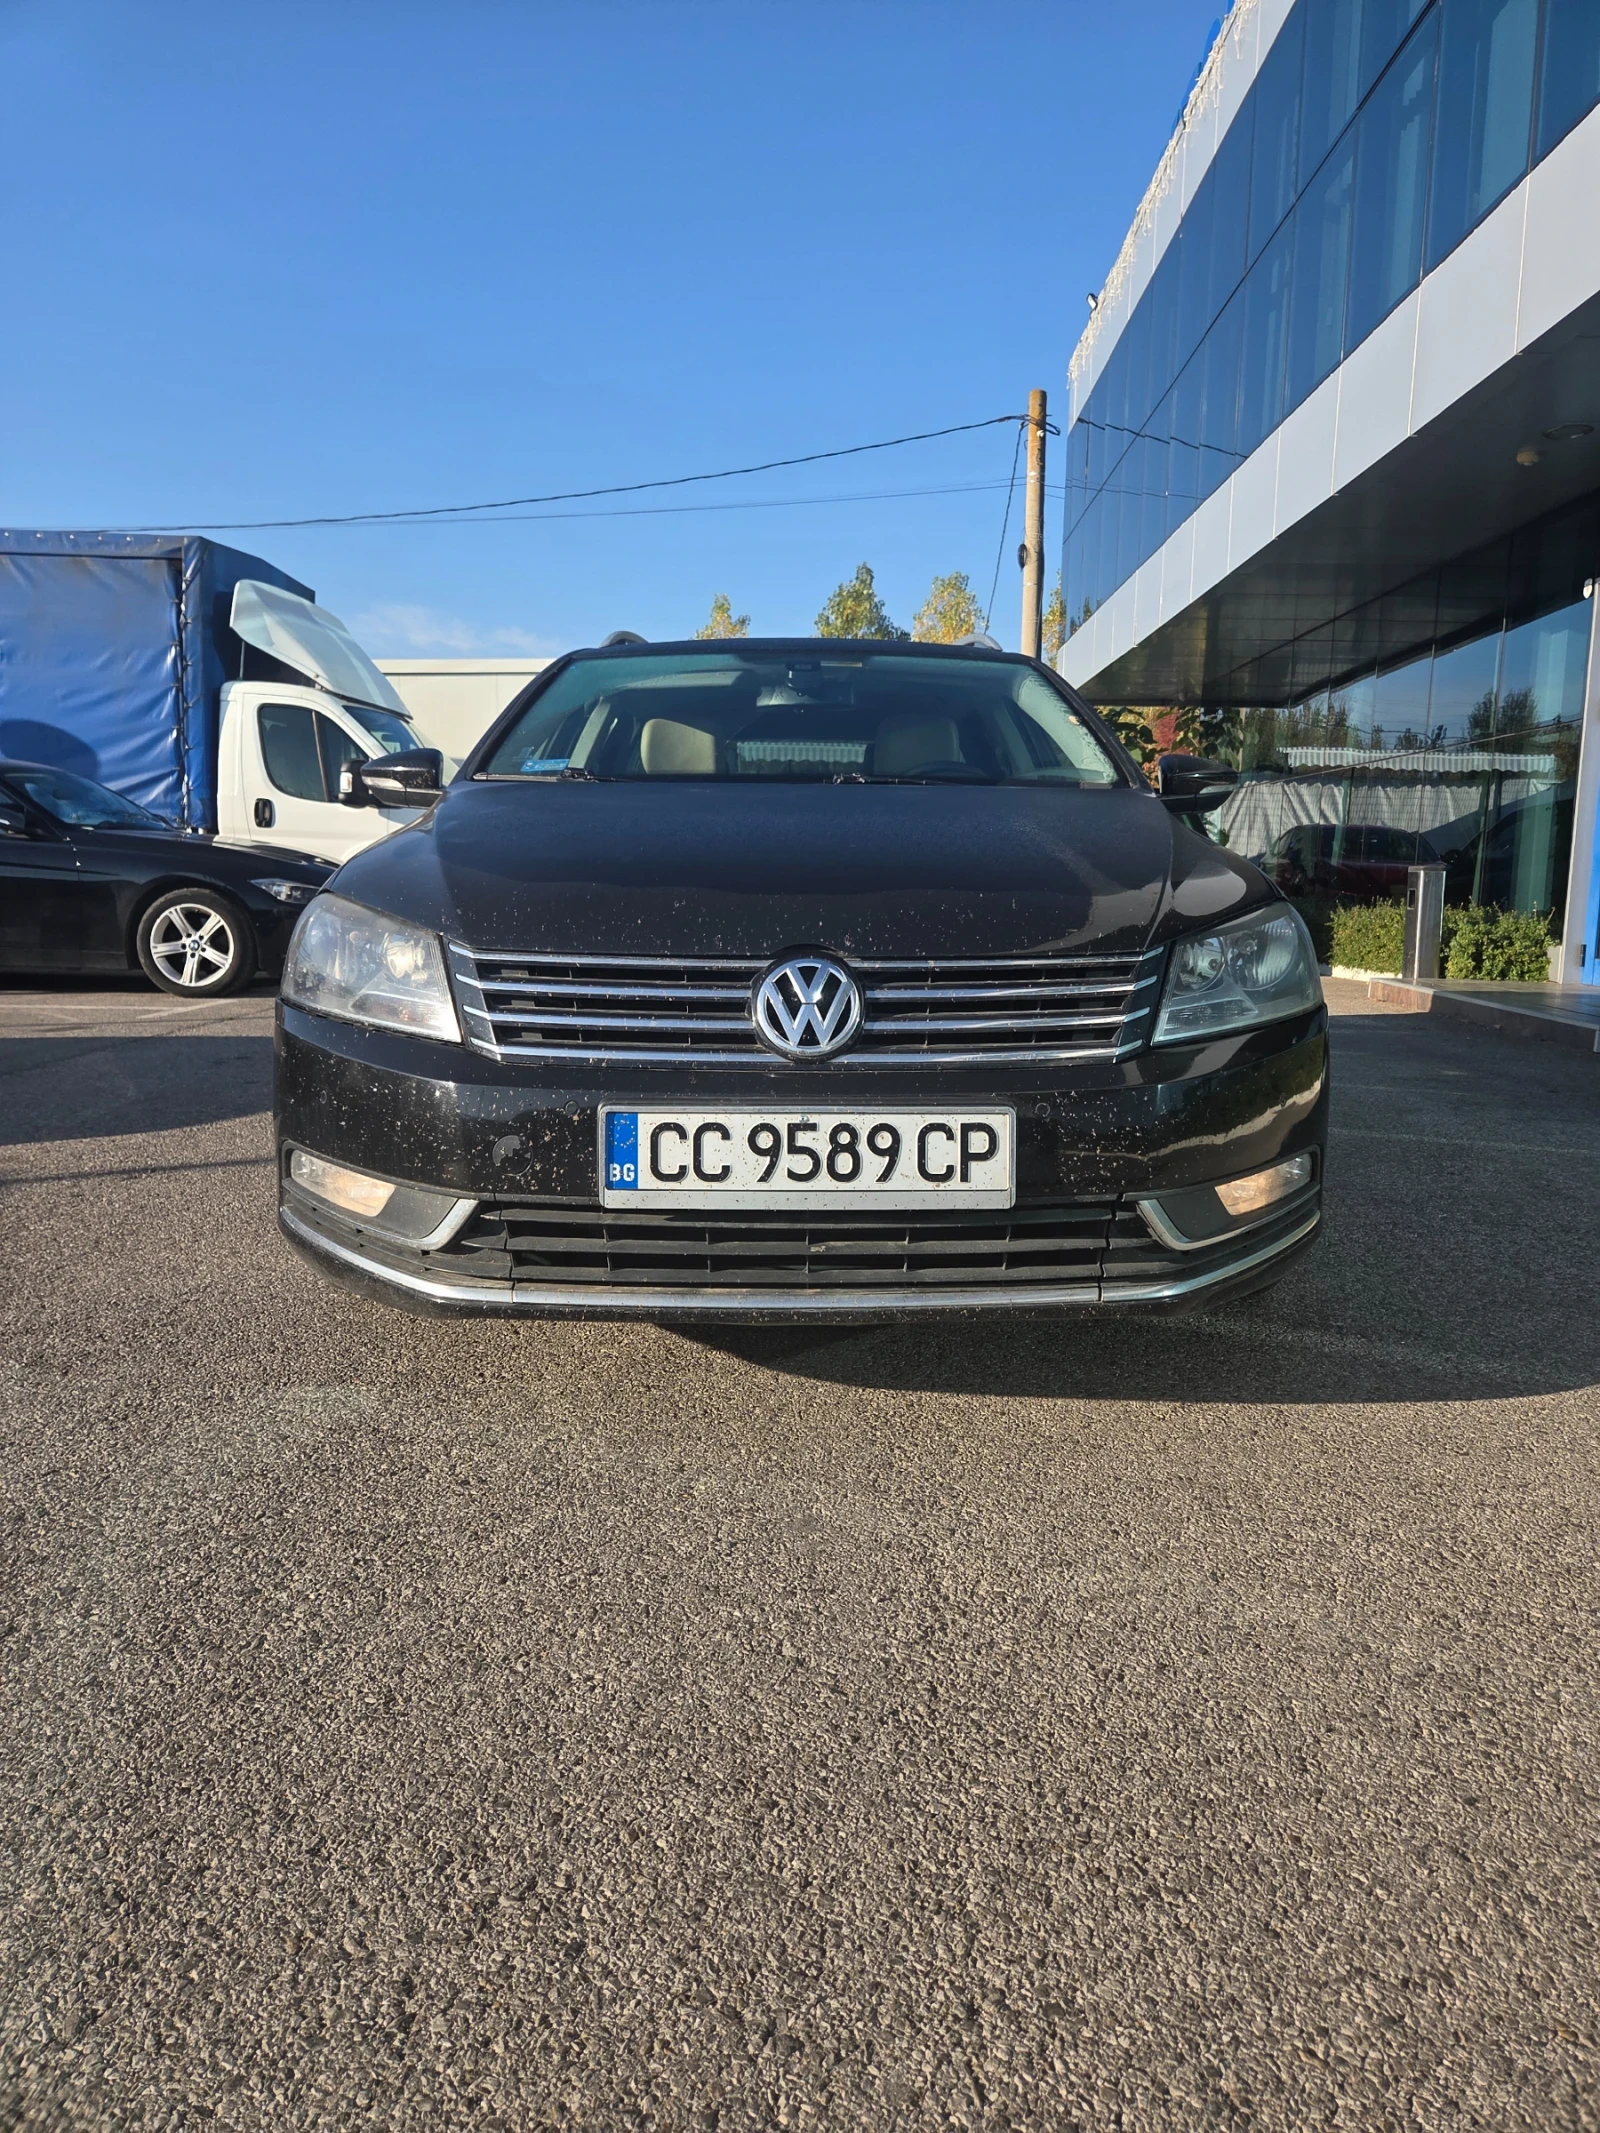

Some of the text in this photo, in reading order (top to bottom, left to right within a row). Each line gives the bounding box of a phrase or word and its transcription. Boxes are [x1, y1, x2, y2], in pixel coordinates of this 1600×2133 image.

[756, 959, 860, 1056] VW
[609, 1163, 635, 1182] BG
[649, 1122, 997, 1183] CC 9589 CP
